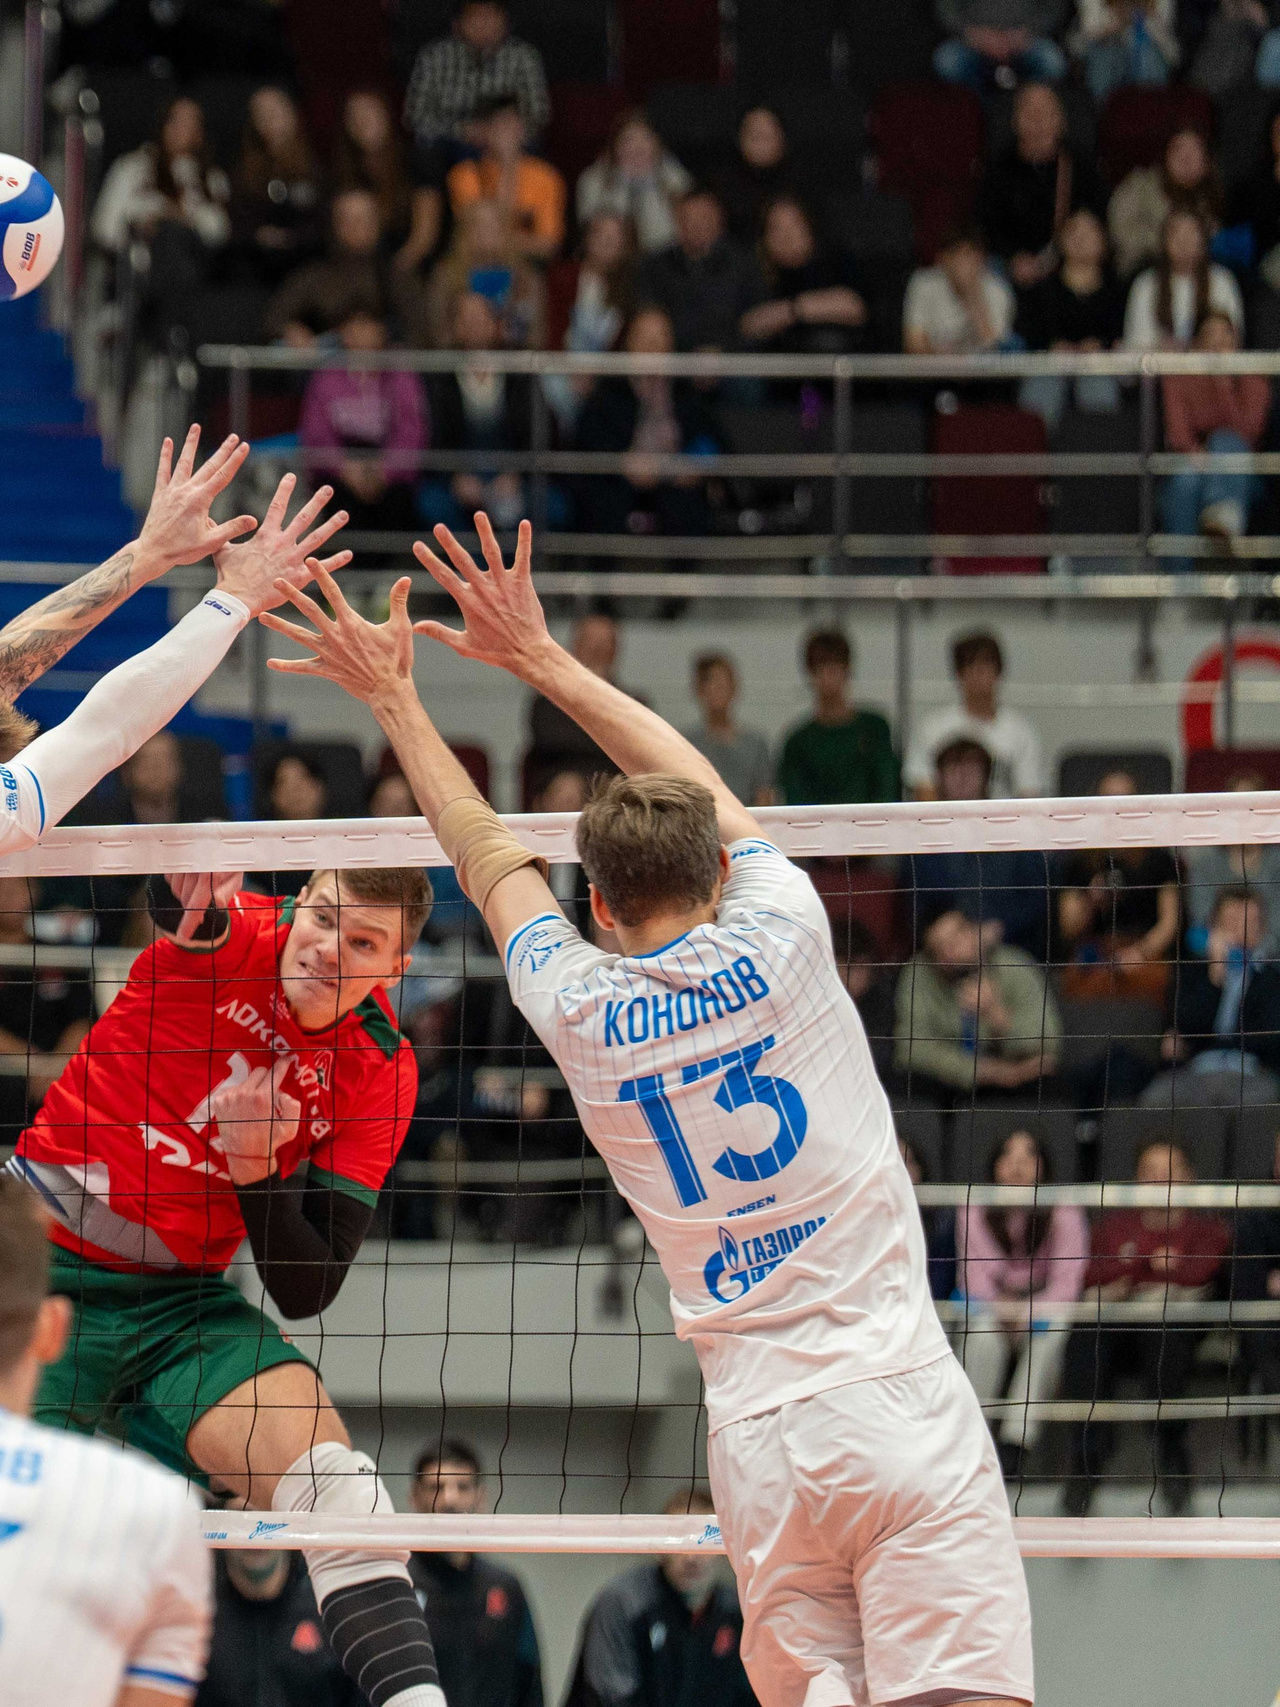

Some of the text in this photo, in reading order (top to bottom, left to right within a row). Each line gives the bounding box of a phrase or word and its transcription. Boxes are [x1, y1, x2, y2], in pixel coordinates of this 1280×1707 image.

[605, 955, 770, 1048] КОНОНОВ
[615, 1034, 808, 1208] 13
[741, 1213, 833, 1266] ГАЗПРО
